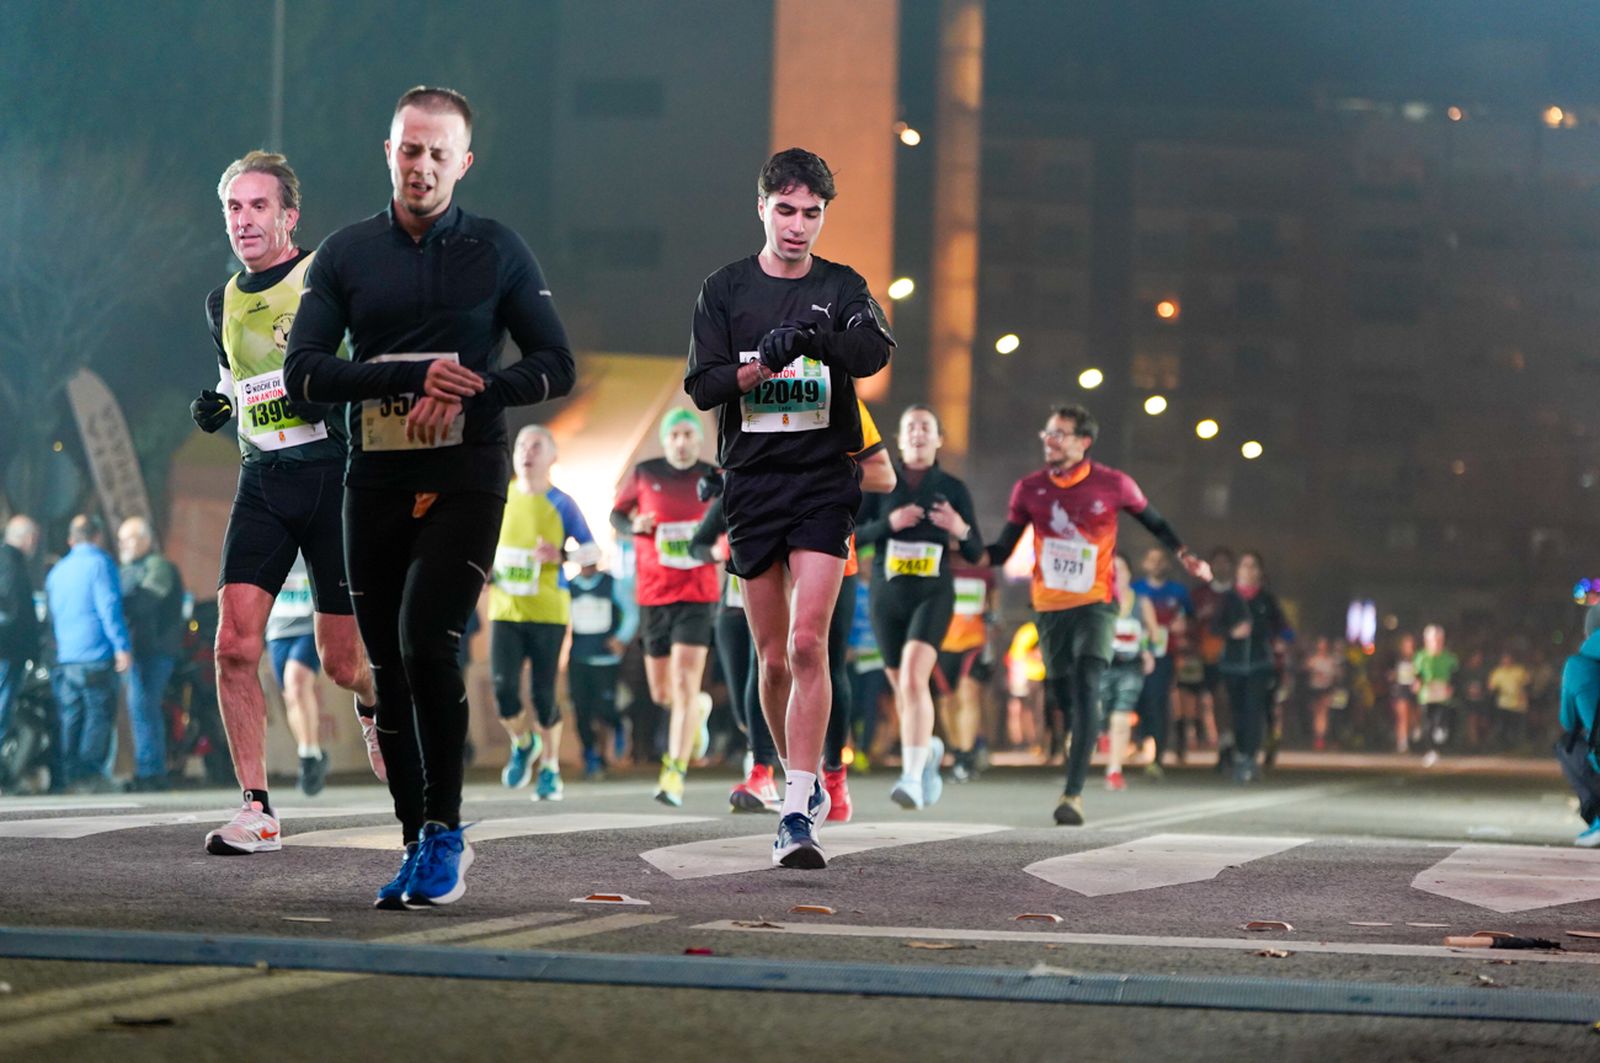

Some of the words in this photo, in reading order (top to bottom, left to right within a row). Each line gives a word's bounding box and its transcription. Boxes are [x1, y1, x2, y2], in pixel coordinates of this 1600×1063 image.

[253, 381, 271, 392] NOCHE
[272, 379, 281, 387] DE
[754, 380, 819, 404] 12049
[247, 394, 259, 405] SAN
[1054, 558, 1084, 576] 5731
